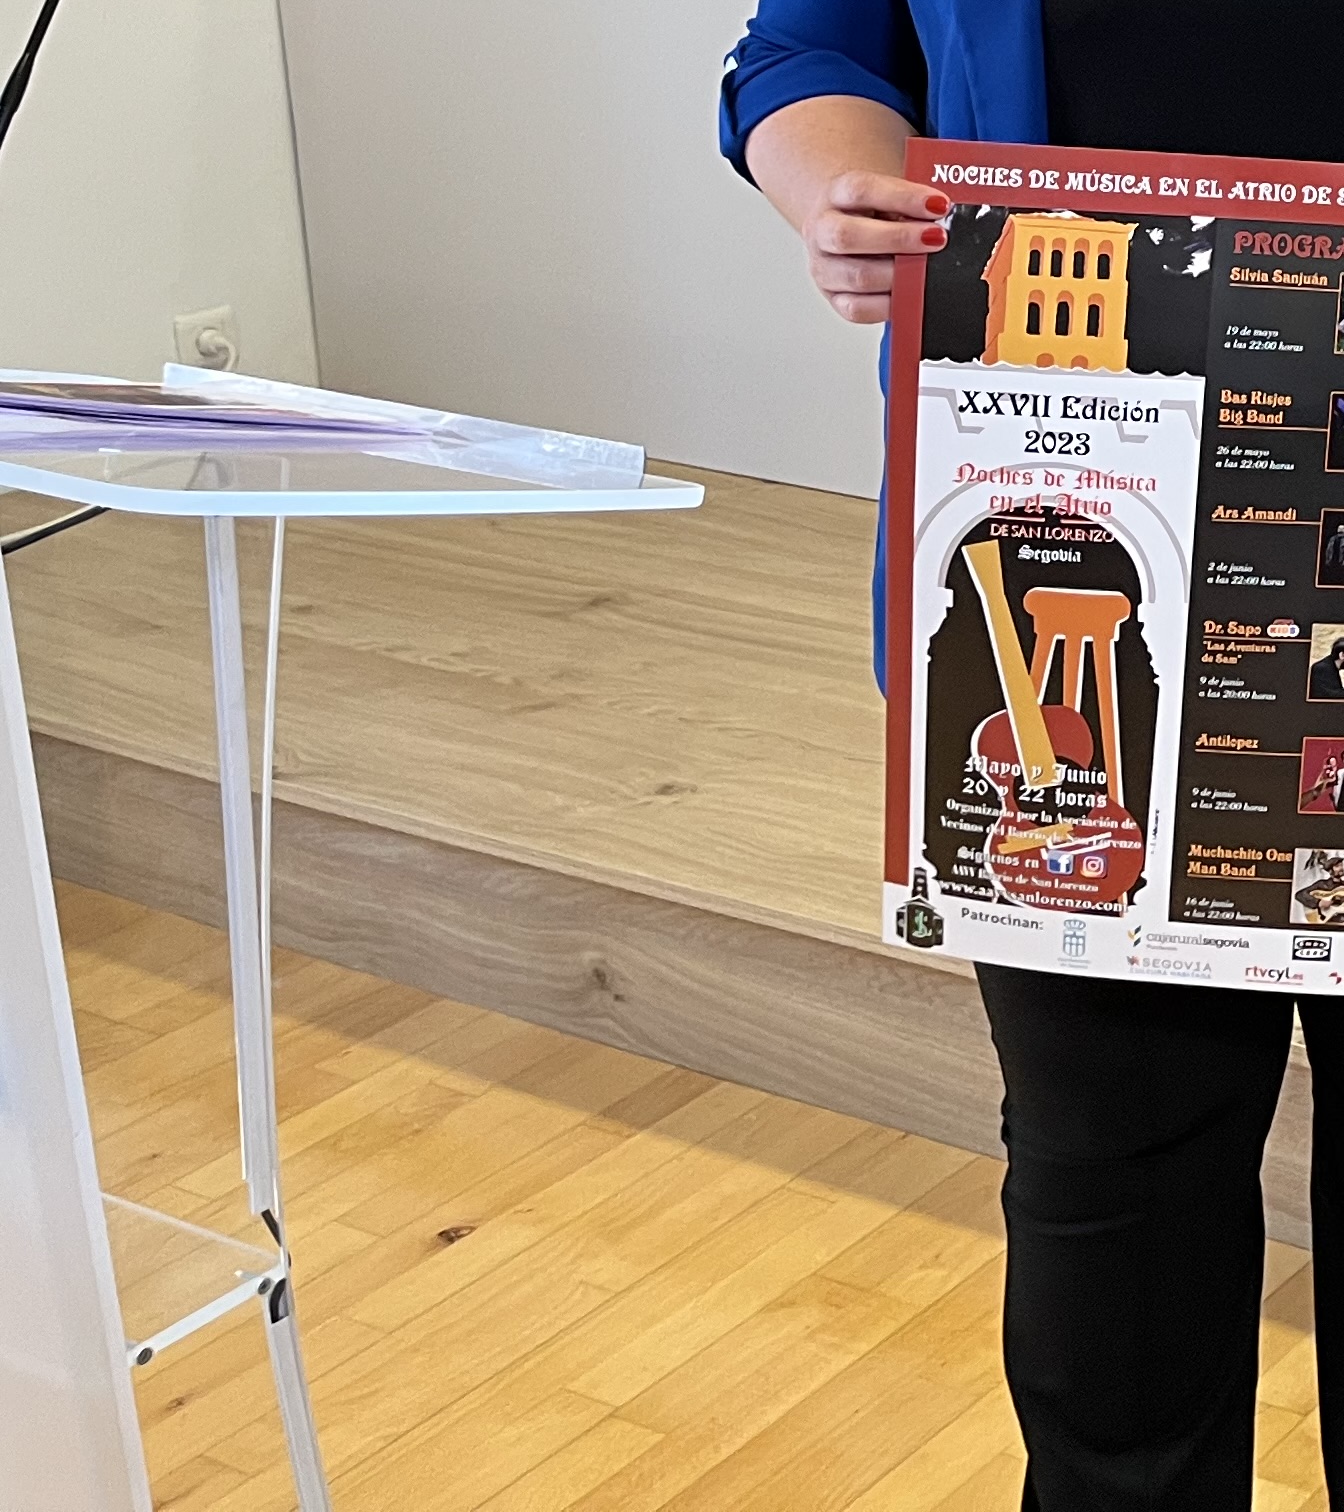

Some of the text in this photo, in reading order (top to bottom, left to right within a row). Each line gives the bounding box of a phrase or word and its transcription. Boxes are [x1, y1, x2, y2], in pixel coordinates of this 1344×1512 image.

[931, 163, 1022, 188] NOCHES
[1028, 169, 1060, 190] DE
[1064, 168, 1152, 196] MÚSICA
[1158, 176, 1190, 197] EN
[1195, 178, 1223, 199] EL
[1228, 181, 1297, 203] ATRIO
[1302, 185, 1332, 205] DE
[1230, 266, 1329, 288] Silvia Sanjuán
[1225, 325, 1279, 342] 19 de mayo
[1232, 339, 1247, 350] las
[1248, 340, 1277, 352] 22:00
[1278, 340, 1304, 353] horas
[1220, 388, 1248, 405] Bas
[958, 389, 1160, 424] XXVII Edición
[1219, 408, 1284, 426] Big Band
[1023, 429, 1091, 456] 2023
[1231, 445, 1243, 457] de
[1243, 448, 1270, 460] mayo
[1223, 458, 1238, 469] las
[1269, 460, 1295, 471] horas
[952, 462, 1157, 492] Noches de Música
[989, 493, 1112, 517] en el Atrio
[1211, 505, 1297, 521] Ars Amandi
[990, 523, 1115, 543] DE SAN LORENZO
[1017, 544, 1082, 564] Segovia
[1204, 620, 1262, 637] Dr. Sapo
[1196, 733, 1259, 749] Antilopez
[964, 756, 1107, 785] Mayo y Junio
[962, 778, 988, 795] 20
[1019, 786, 1044, 803] 22
[1055, 790, 1107, 808] horas
[1017, 810, 1038, 823] por
[1041, 810, 1053, 823] la
[1055, 812, 1118, 828] Asociación
[1121, 818, 1137, 829] de
[1188, 844, 1292, 862] Muchachito One
[1025, 858, 1039, 868] en
[1187, 861, 1256, 876] Man Band
[961, 908, 1044, 930] Patrocinan:
[1142, 957, 1212, 972] SEGOVIA
